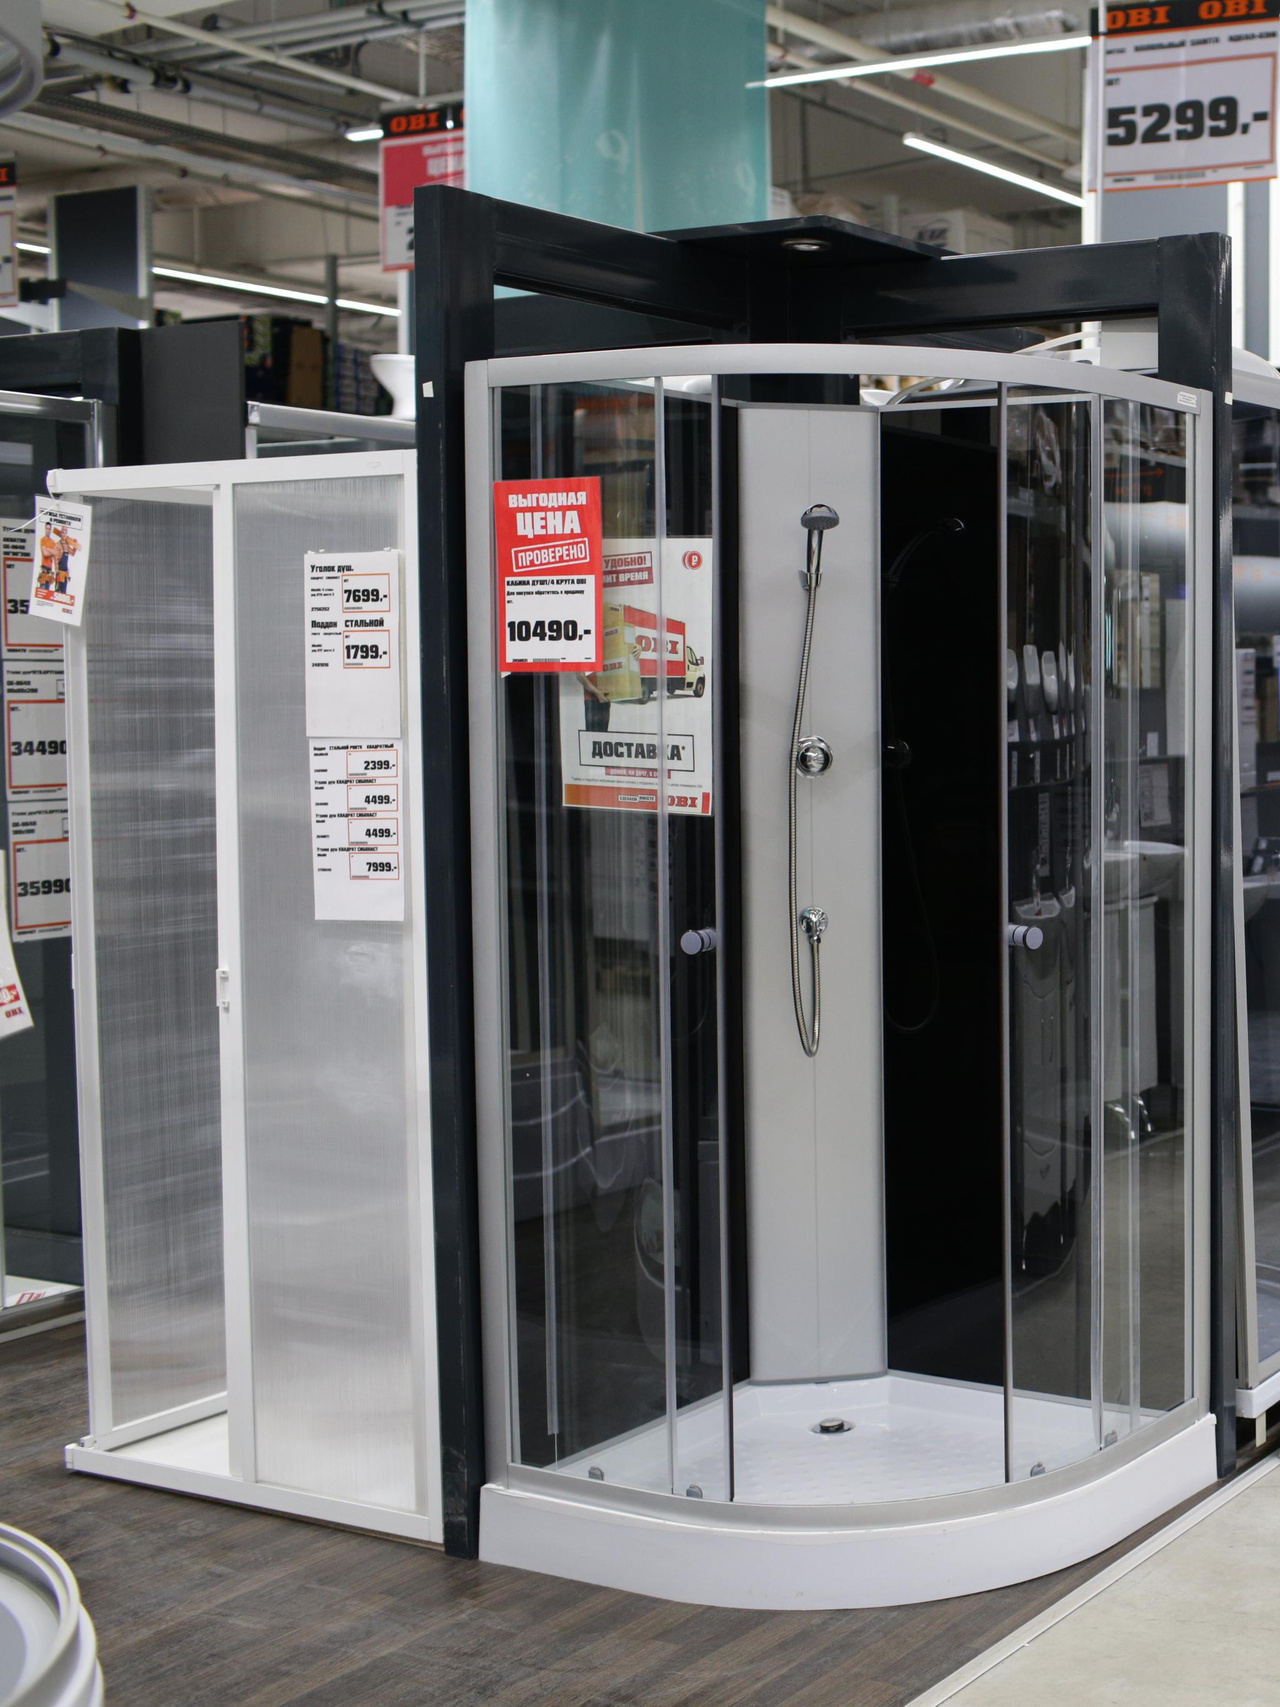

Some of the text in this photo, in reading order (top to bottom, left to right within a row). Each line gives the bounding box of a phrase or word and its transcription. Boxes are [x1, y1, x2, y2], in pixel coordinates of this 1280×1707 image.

[1106, 0, 1267, 29] OBI OBI
[390, 112, 440, 132] OBI
[1107, 95, 1269, 147] 5299,-
[508, 491, 587, 508] ВЫГОДНАЯ
[516, 510, 581, 538] ЦЕНА
[518, 543, 585, 567] ПРОВЕРЕНО
[604, 555, 647, 569] УДОБНО!
[310, 564, 354, 573] Уголок душ.
[619, 571, 648, 582] ВРЕМЯ
[344, 588, 388, 603] 7699,-
[311, 617, 385, 629] Поддон СТАЛЬНОЙ
[507, 619, 591, 642] 10490,-
[345, 644, 388, 660] 1799,-
[668, 795, 698, 808] OBI
